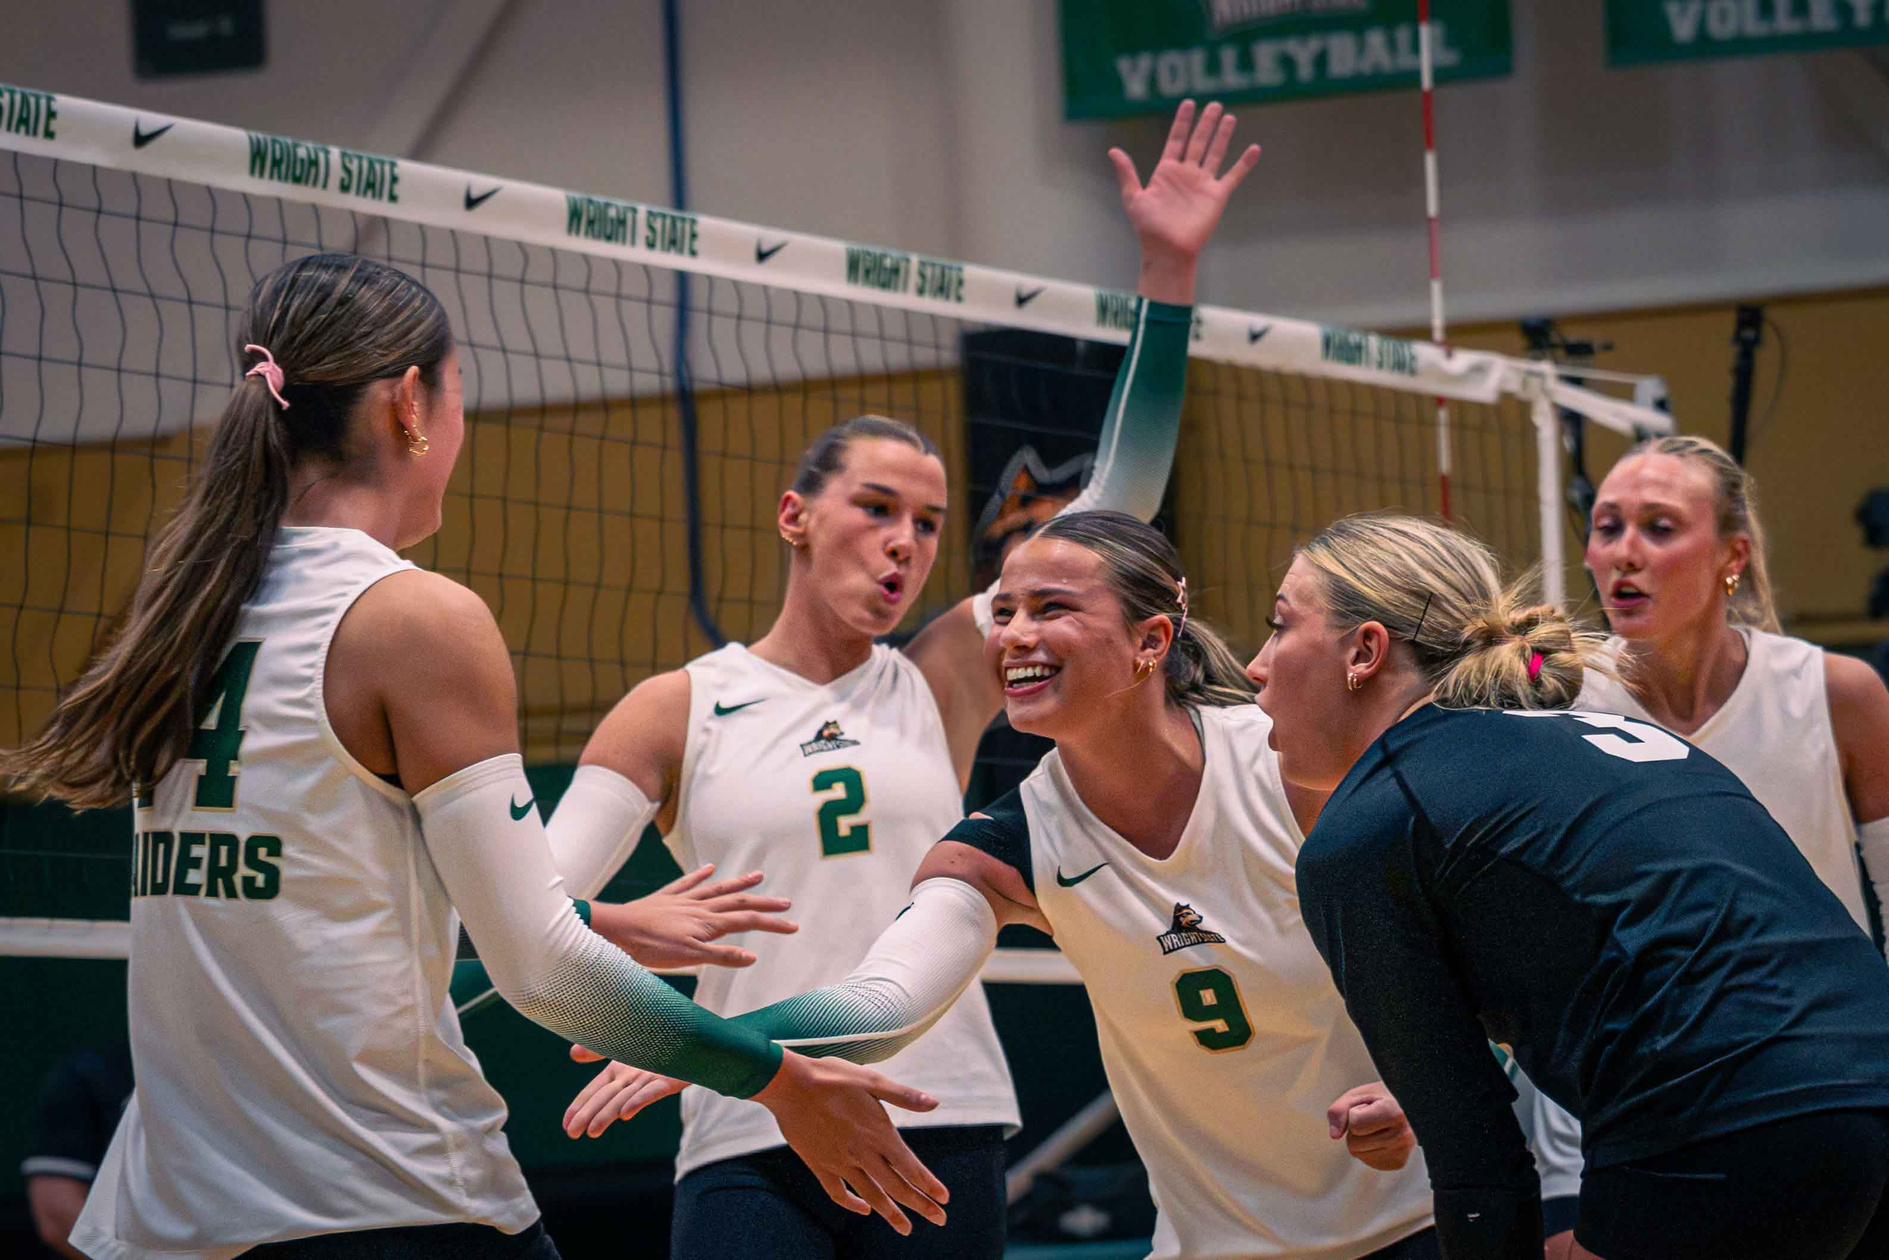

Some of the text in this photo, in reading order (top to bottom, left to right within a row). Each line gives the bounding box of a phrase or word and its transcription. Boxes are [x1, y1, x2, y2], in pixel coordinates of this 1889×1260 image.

[1665, 0, 1889, 43] VOLLEY
[1116, 22, 1461, 100] VOLLEYBALL
[0, 86, 57, 139] TATE
[248, 133, 399, 203] WRIGHT STATE
[566, 194, 699, 256] WRIGHT STATE
[846, 246, 964, 303] WRIGHT STATE
[811, 766, 872, 859] 2
[134, 830, 283, 900] IDERS
[1160, 932, 1203, 952] WRIGHT
[1171, 965, 1255, 1054] 9
